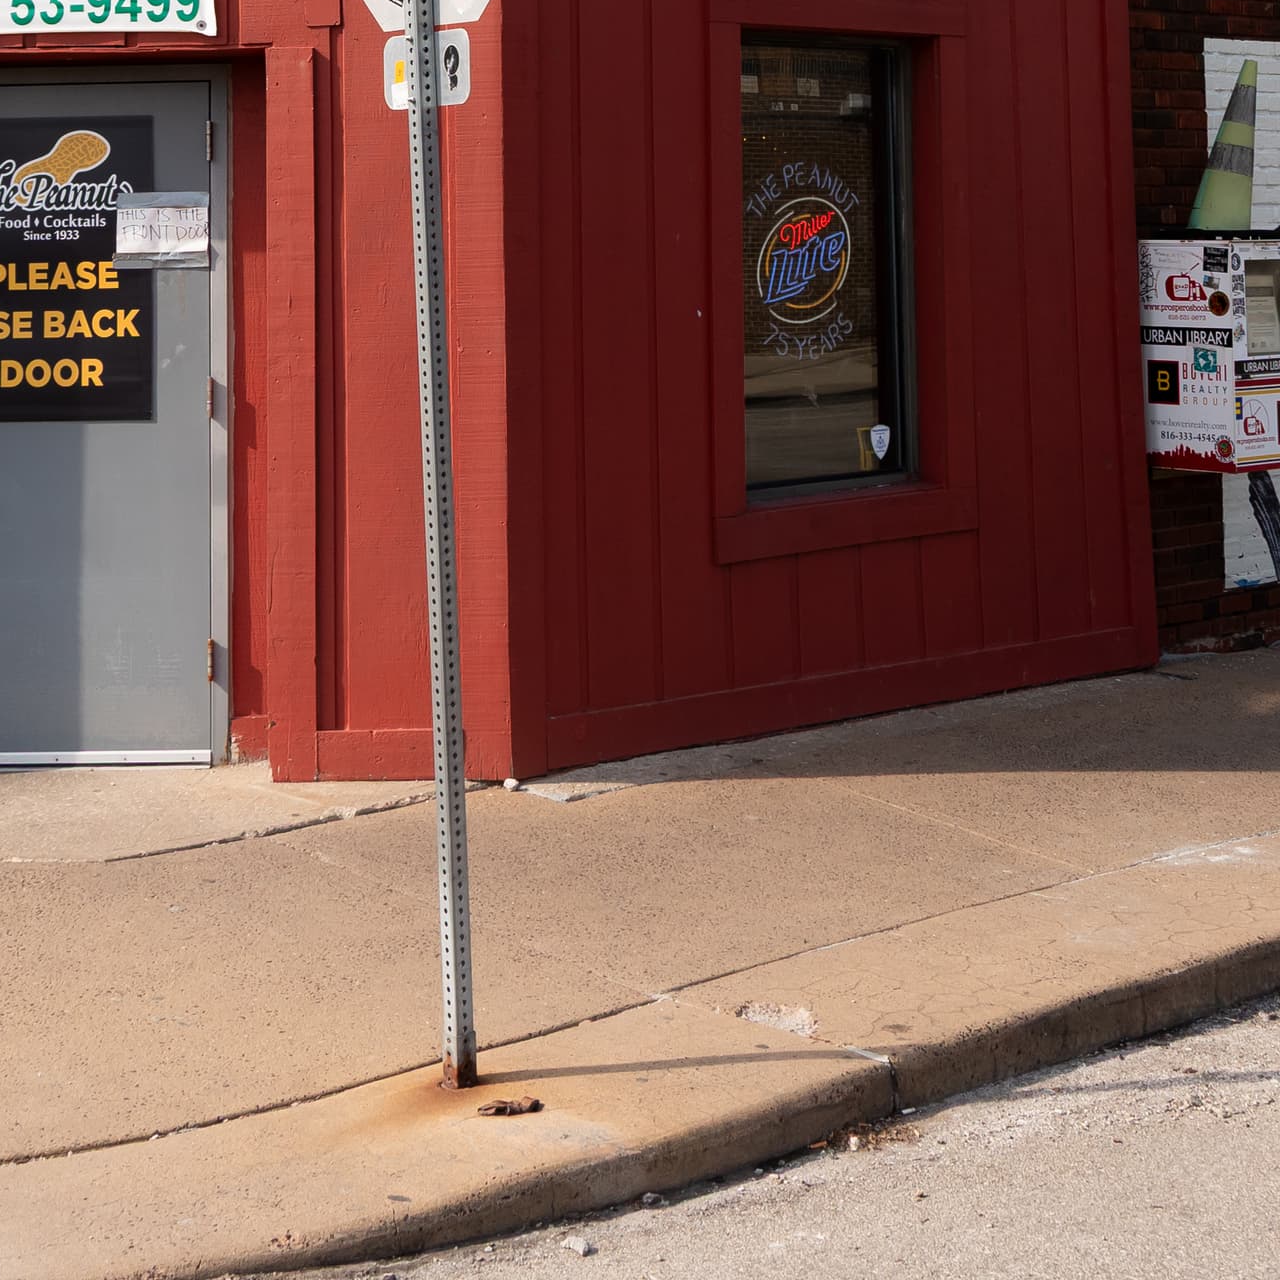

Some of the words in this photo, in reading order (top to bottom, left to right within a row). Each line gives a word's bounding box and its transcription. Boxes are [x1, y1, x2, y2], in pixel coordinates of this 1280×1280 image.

[20, 172, 121, 212] Peanut
[746, 172, 782, 217] THE
[781, 161, 861, 213] PEANUT
[43, 213, 107, 228] Cocktails
[119, 208, 147, 222] THIS
[157, 208, 171, 222] IS
[176, 208, 205, 222] THE
[23, 230, 52, 241] Since
[53, 230, 80, 241] 1933
[121, 224, 176, 243] FRONT
[779, 210, 836, 250] Miller
[763, 230, 846, 305] Lite
[43, 309, 141, 340] BACK
[793, 312, 853, 361] YEARS
[1143, 328, 1183, 344] URBAN
[1186, 330, 1230, 346] LIBRARY
[0, 358, 104, 389] DOOR
[1243, 360, 1269, 373] URBAN
[1182, 383, 1228, 395] REALTY
[1182, 395, 1229, 407] GROUP
[1160, 430, 1217, 443] 816-333-4545
